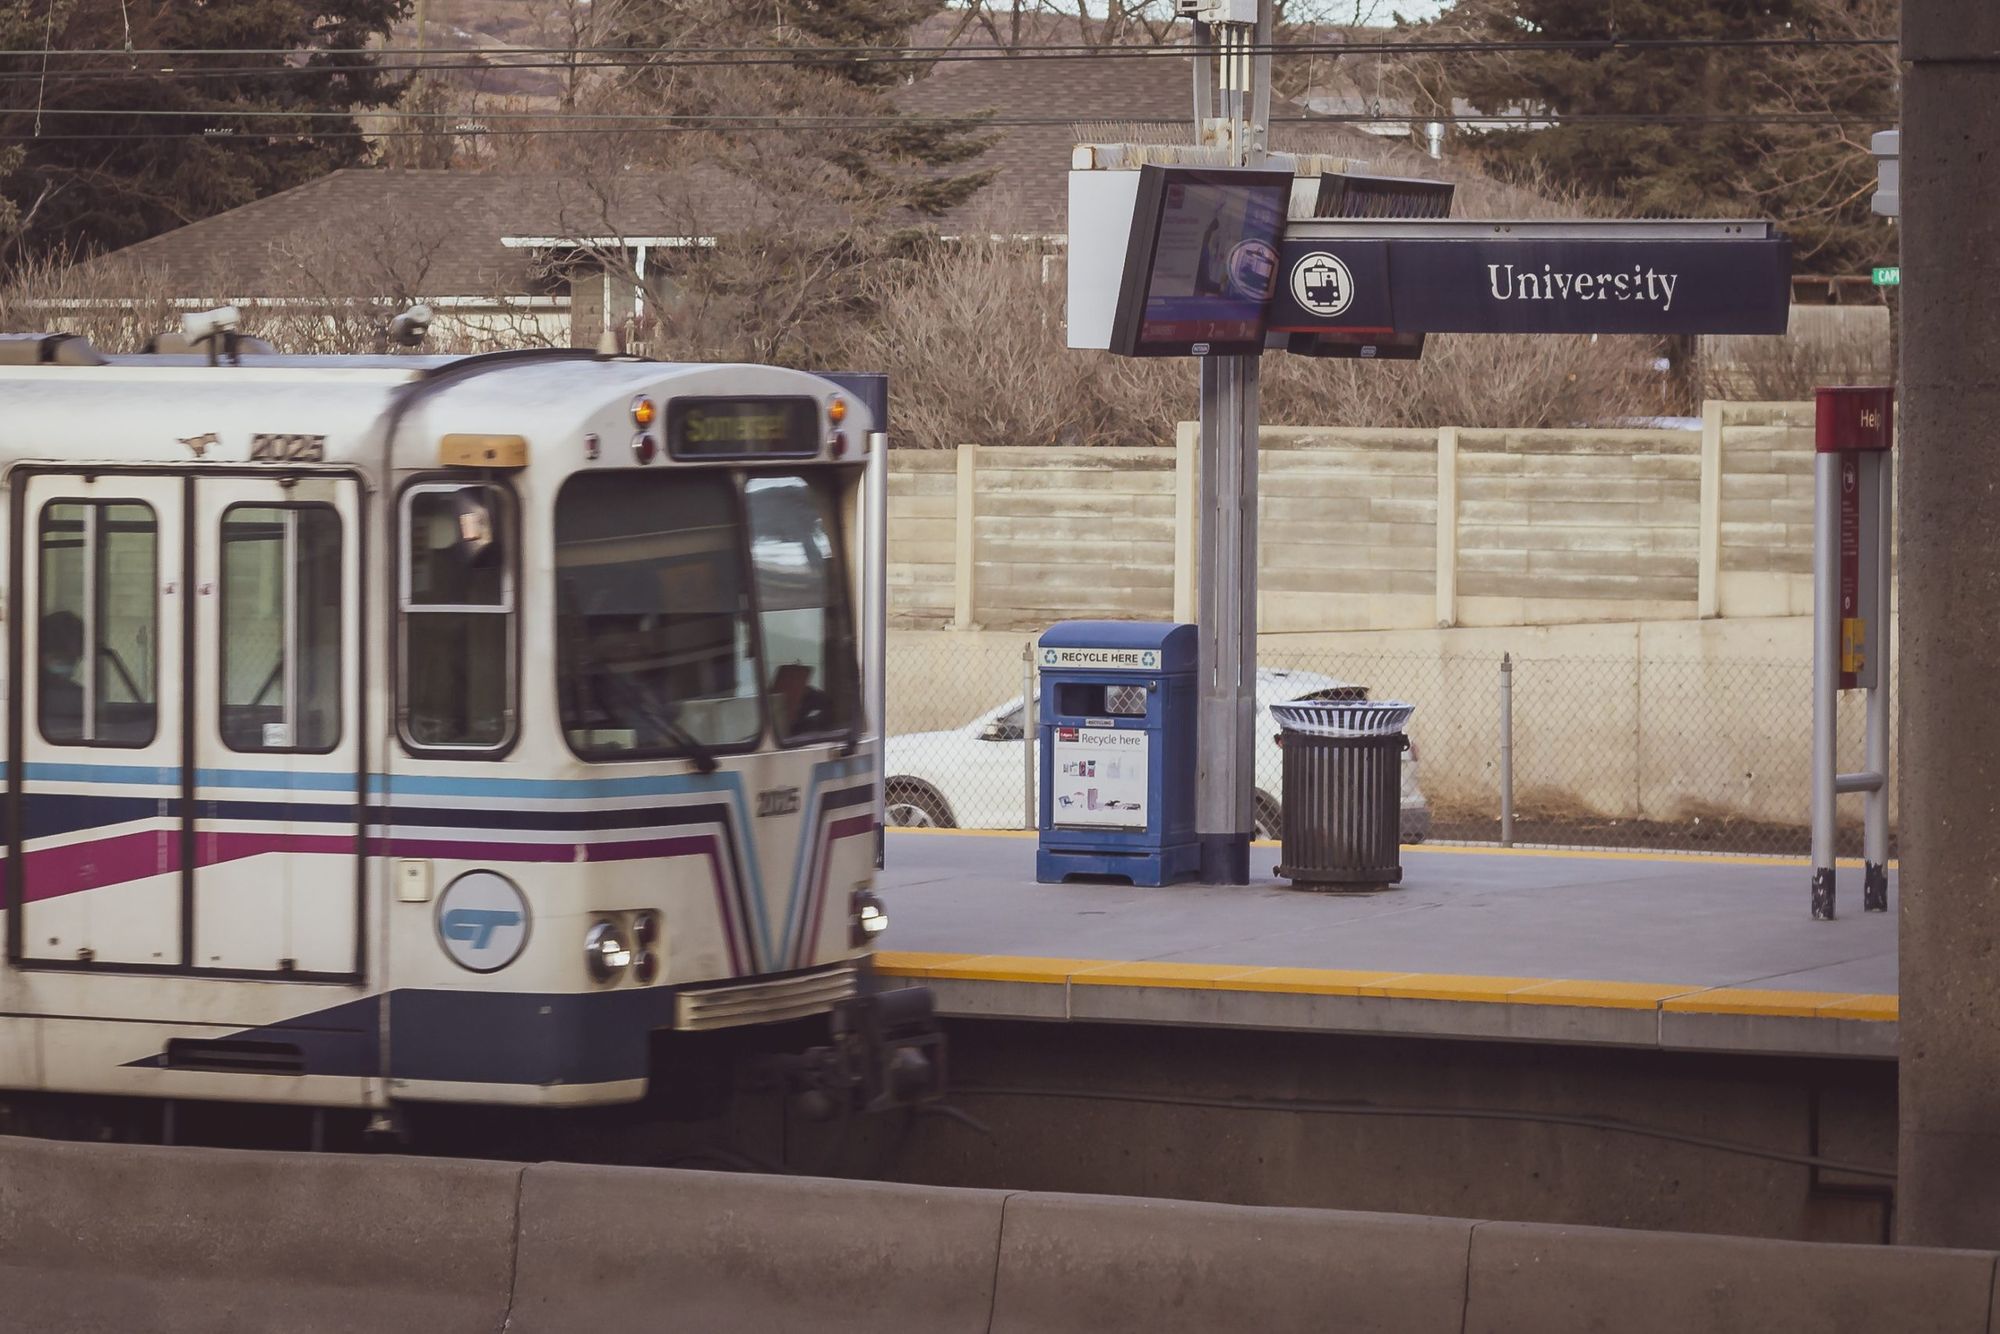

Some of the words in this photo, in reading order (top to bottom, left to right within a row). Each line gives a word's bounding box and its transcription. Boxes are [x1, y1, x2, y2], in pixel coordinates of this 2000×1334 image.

[1487, 264, 1678, 311] University
[250, 433, 326, 462] 2025
[1061, 652, 1108, 662] RECYCLE
[1111, 654, 1138, 664] HERE
[1081, 733, 1117, 746] Recycle
[1119, 734, 1141, 745] here
